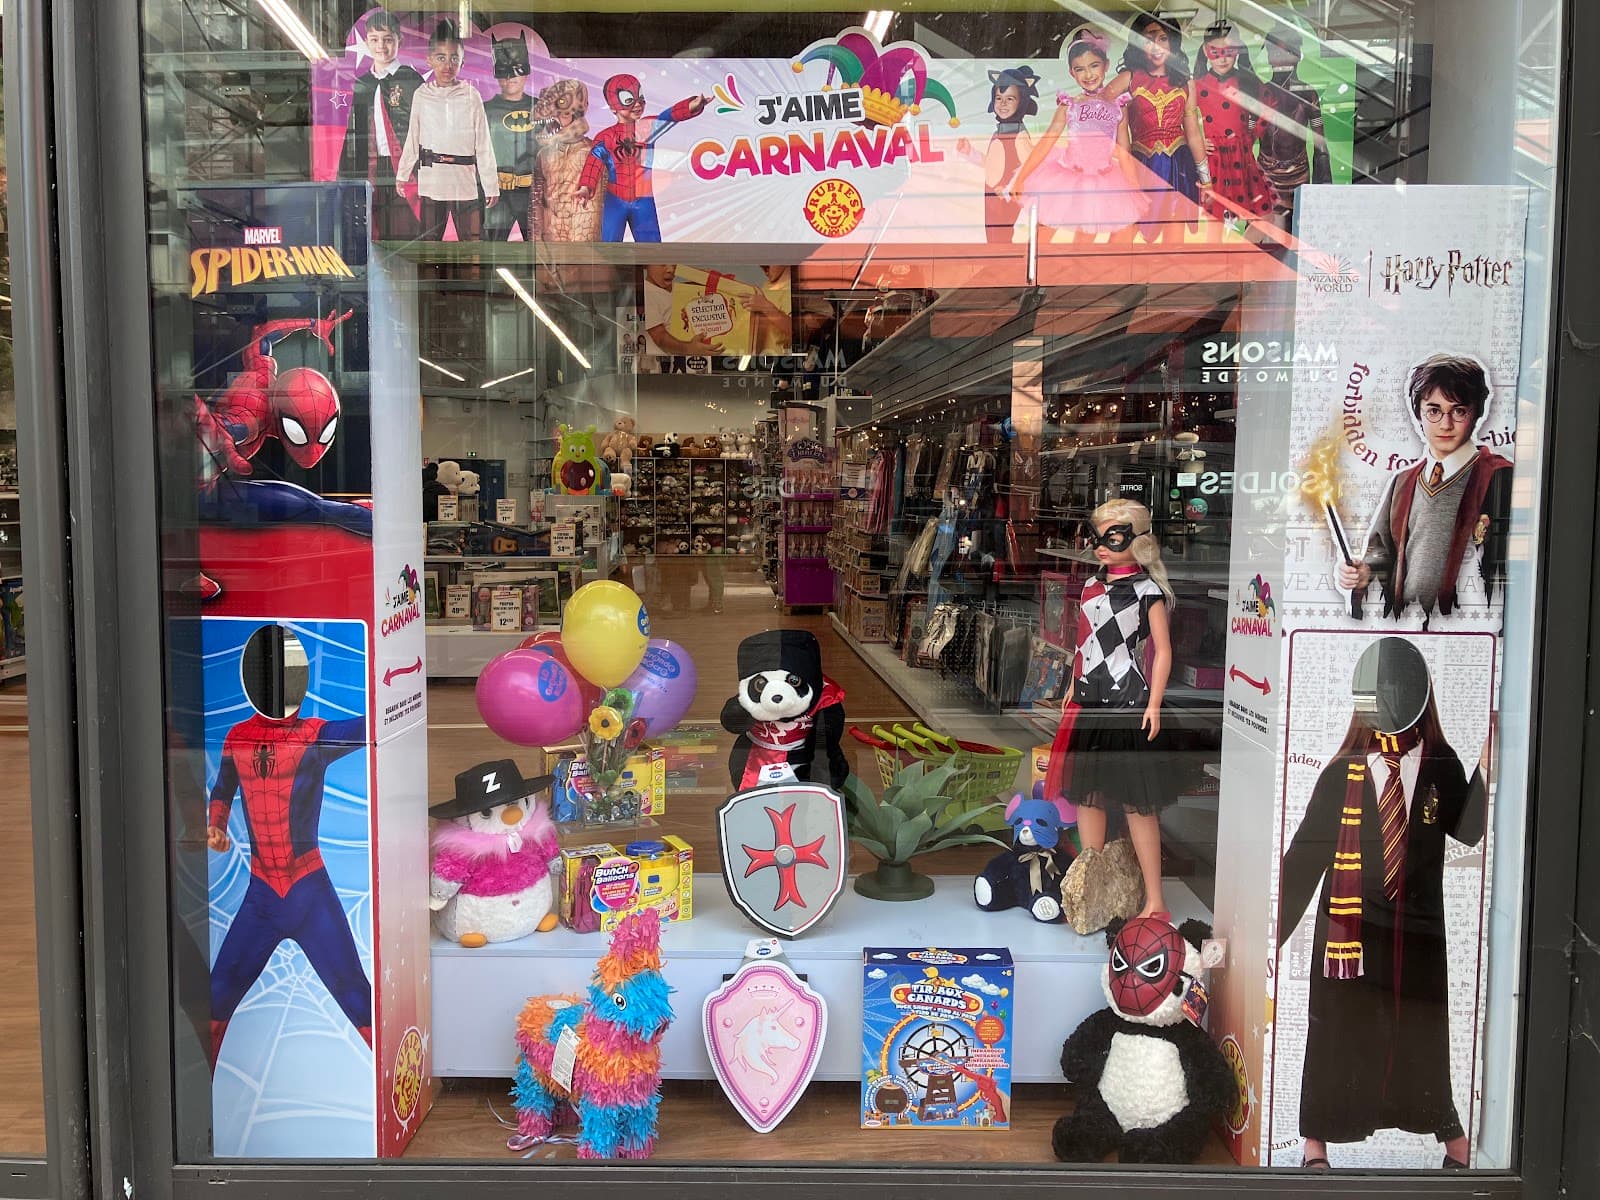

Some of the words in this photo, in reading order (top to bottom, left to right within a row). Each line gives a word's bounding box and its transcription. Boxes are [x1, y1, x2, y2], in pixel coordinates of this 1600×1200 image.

[758, 92, 862, 124] J'AIME
[1079, 104, 1114, 121] Barbie
[690, 123, 944, 180] CARNAVAL
[808, 182, 859, 209] RUBIES
[244, 228, 281, 244] MARVEL
[1307, 275, 1360, 284] WIZARDING
[1380, 254, 1445, 296] Harry
[1447, 249, 1513, 298] Potter
[1314, 283, 1353, 293] WORLD
[1342, 361, 1379, 468] forbidden
[392, 590, 409, 609] J'AIME
[1242, 600, 1259, 613] J'AIME
[380, 603, 421, 638] CARNAVAL
[1231, 616, 1272, 638] CARNAVAL
[481, 771, 501, 794] Z
[911, 984, 934, 994] TIR
[937, 986, 964, 998] AUX
[907, 993, 967, 1010] CANARDS
